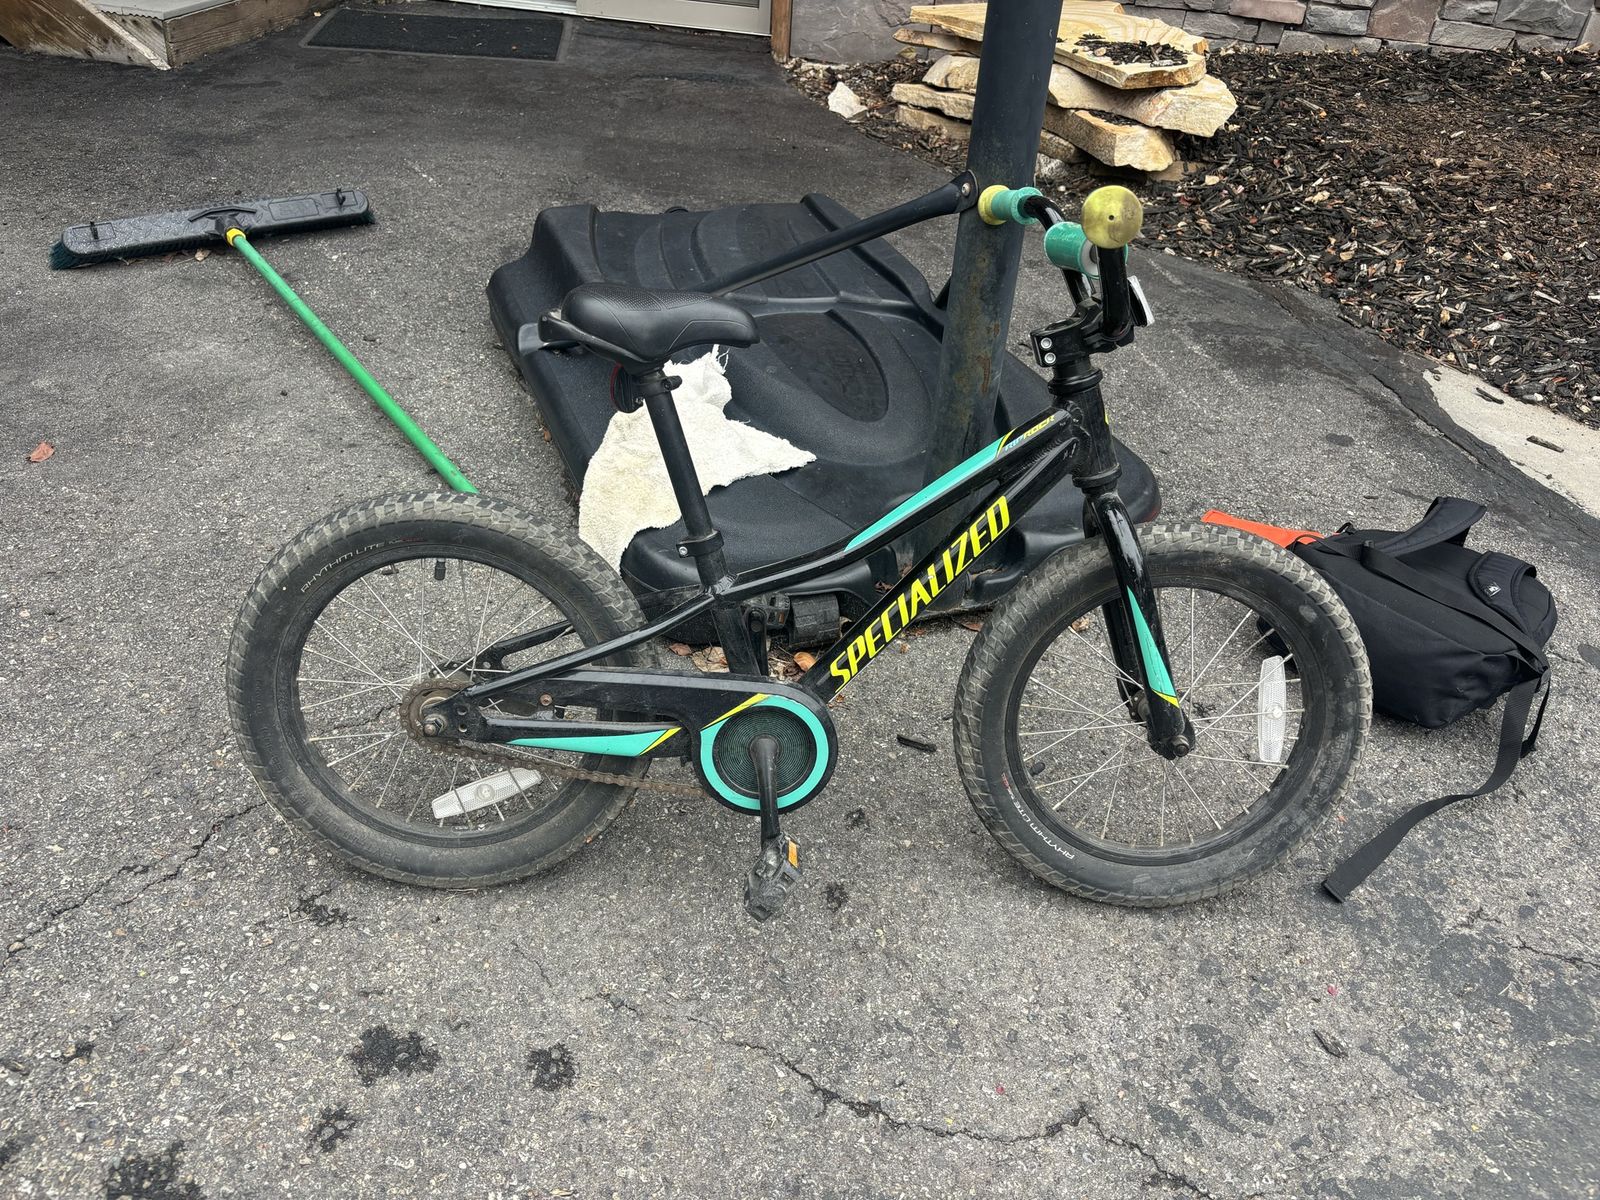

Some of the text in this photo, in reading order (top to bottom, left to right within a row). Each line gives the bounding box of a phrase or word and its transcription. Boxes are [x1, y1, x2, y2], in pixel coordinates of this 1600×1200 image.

[300, 542, 386, 593] RHYTHM LITE
[829, 495, 1010, 693] SPECIALIZED
[1013, 801, 1075, 860] RHYTHM LITE
